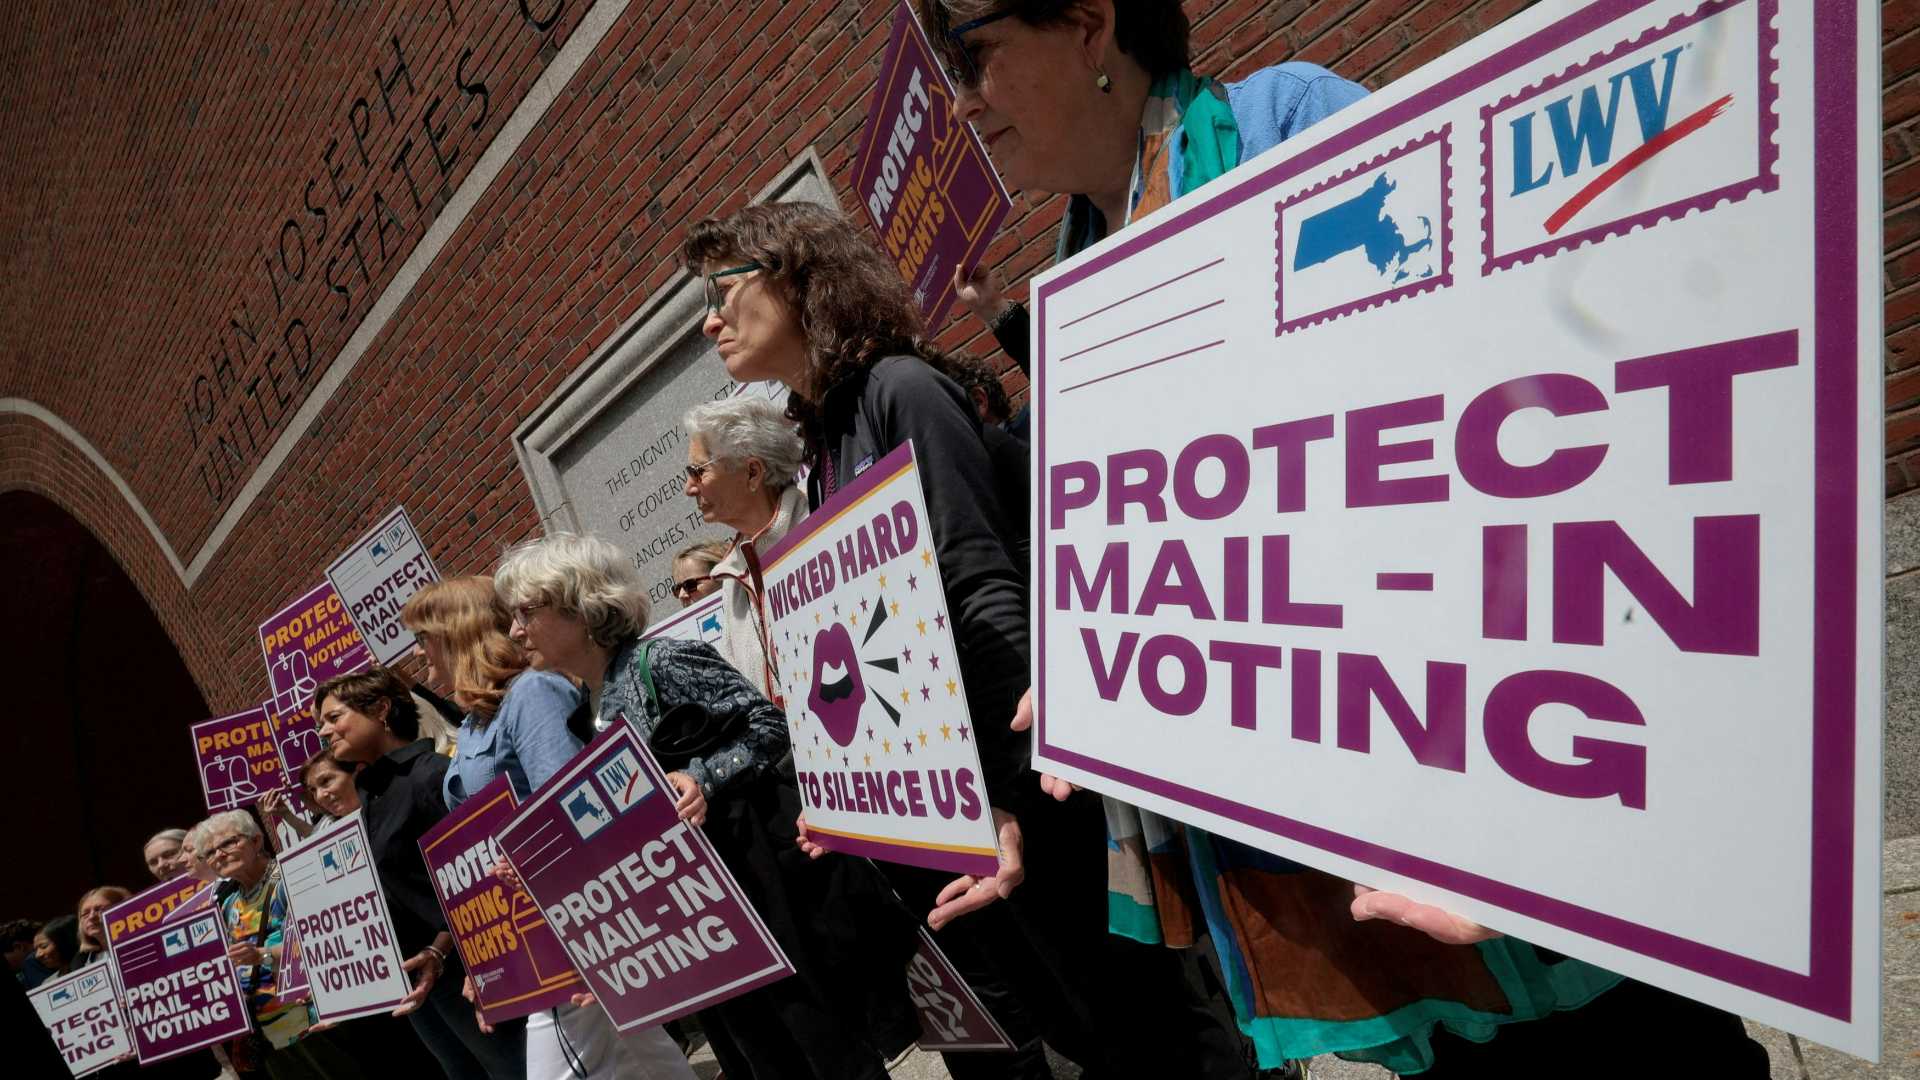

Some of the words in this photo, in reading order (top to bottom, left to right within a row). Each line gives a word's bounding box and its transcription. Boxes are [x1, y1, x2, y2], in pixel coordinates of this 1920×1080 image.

[868, 66, 930, 229] PROTECT
[884, 154, 933, 258] VOTING
[184, 300, 257, 450] JOHN
[265, 36, 416, 315] JOSEPH
[898, 191, 945, 287] RIGHTS
[200, 318, 312, 502] UNITED
[326, 47, 490, 322] STATES
[605, 466, 632, 496] THE
[630, 425, 682, 477] DIGNITY
[1049, 329, 1799, 530] PROTECT
[619, 512, 636, 532] OF
[637, 468, 689, 519] GOVERN
[632, 523, 688, 569] ANCHES,
[686, 511, 705, 532] TH
[767, 549, 835, 622] WICKED
[836, 500, 919, 584] HARD
[351, 553, 427, 620] PROTECT
[264, 593, 341, 655] PROTEC
[303, 612, 352, 650] MAIL-I
[1079, 627, 1648, 811] VOTING
[798, 770, 821, 809] TO
[822, 768, 928, 817] SILENCE
[928, 767, 982, 821] US
[436, 834, 503, 901] PROTEC
[545, 821, 697, 938] PROTECT
[297, 890, 380, 942] PROTECT
[450, 885, 510, 936] VOTING
[317, 954, 391, 993] VOTING
[460, 921, 518, 967] RIGHTS
[597, 915, 738, 997] VOTING
[125, 955, 228, 1007] PROTECT
[51, 998, 114, 1034] TECT
[142, 1001, 231, 1043] VOTING
[66, 1035, 115, 1064] ING
